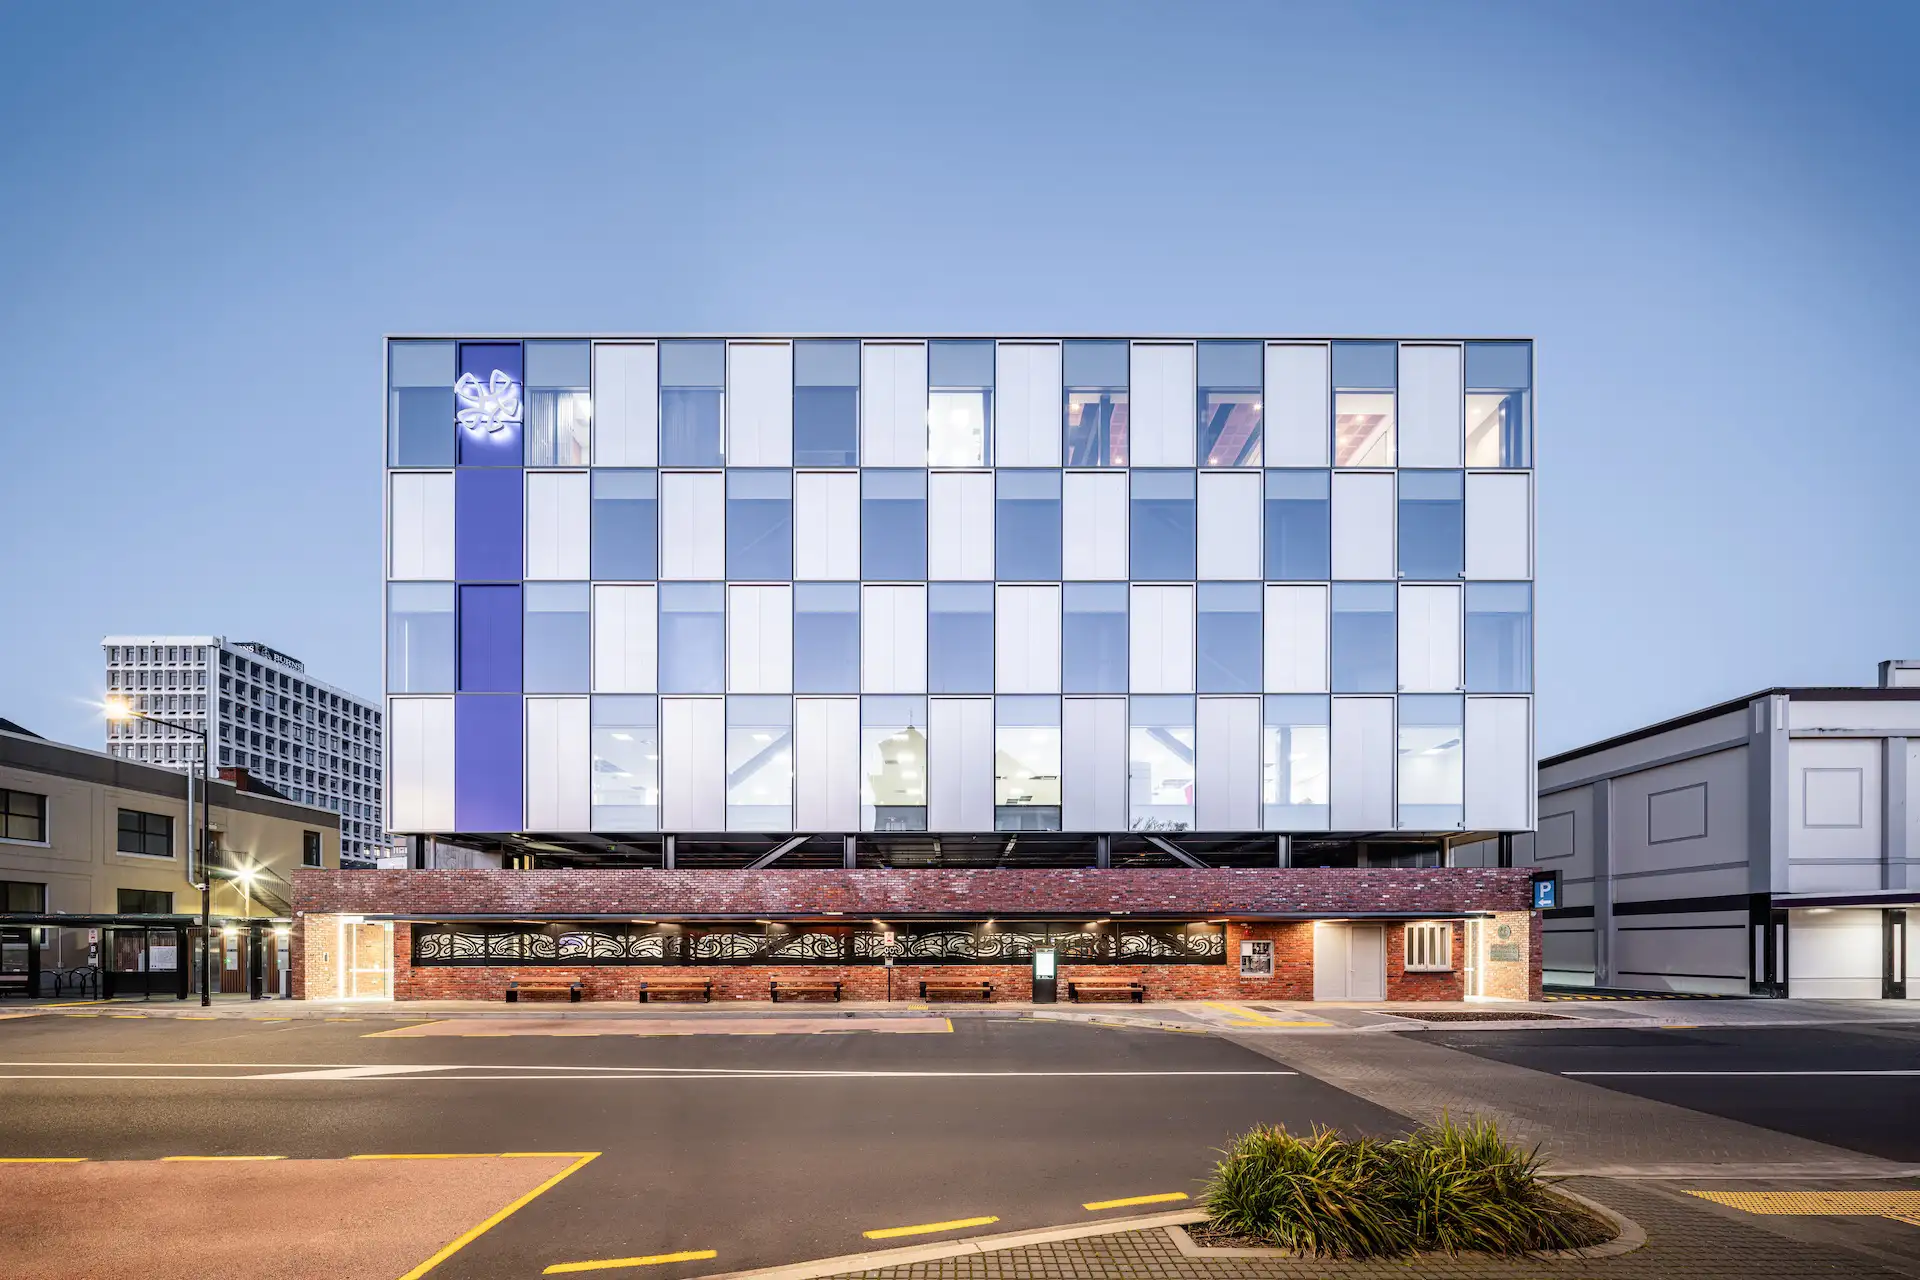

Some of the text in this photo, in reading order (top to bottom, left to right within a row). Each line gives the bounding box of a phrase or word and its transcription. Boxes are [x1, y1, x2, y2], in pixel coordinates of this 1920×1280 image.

[273, 653, 303, 670] BURNS
[1540, 882, 1551, 898] P
[90, 945, 96, 953] B
